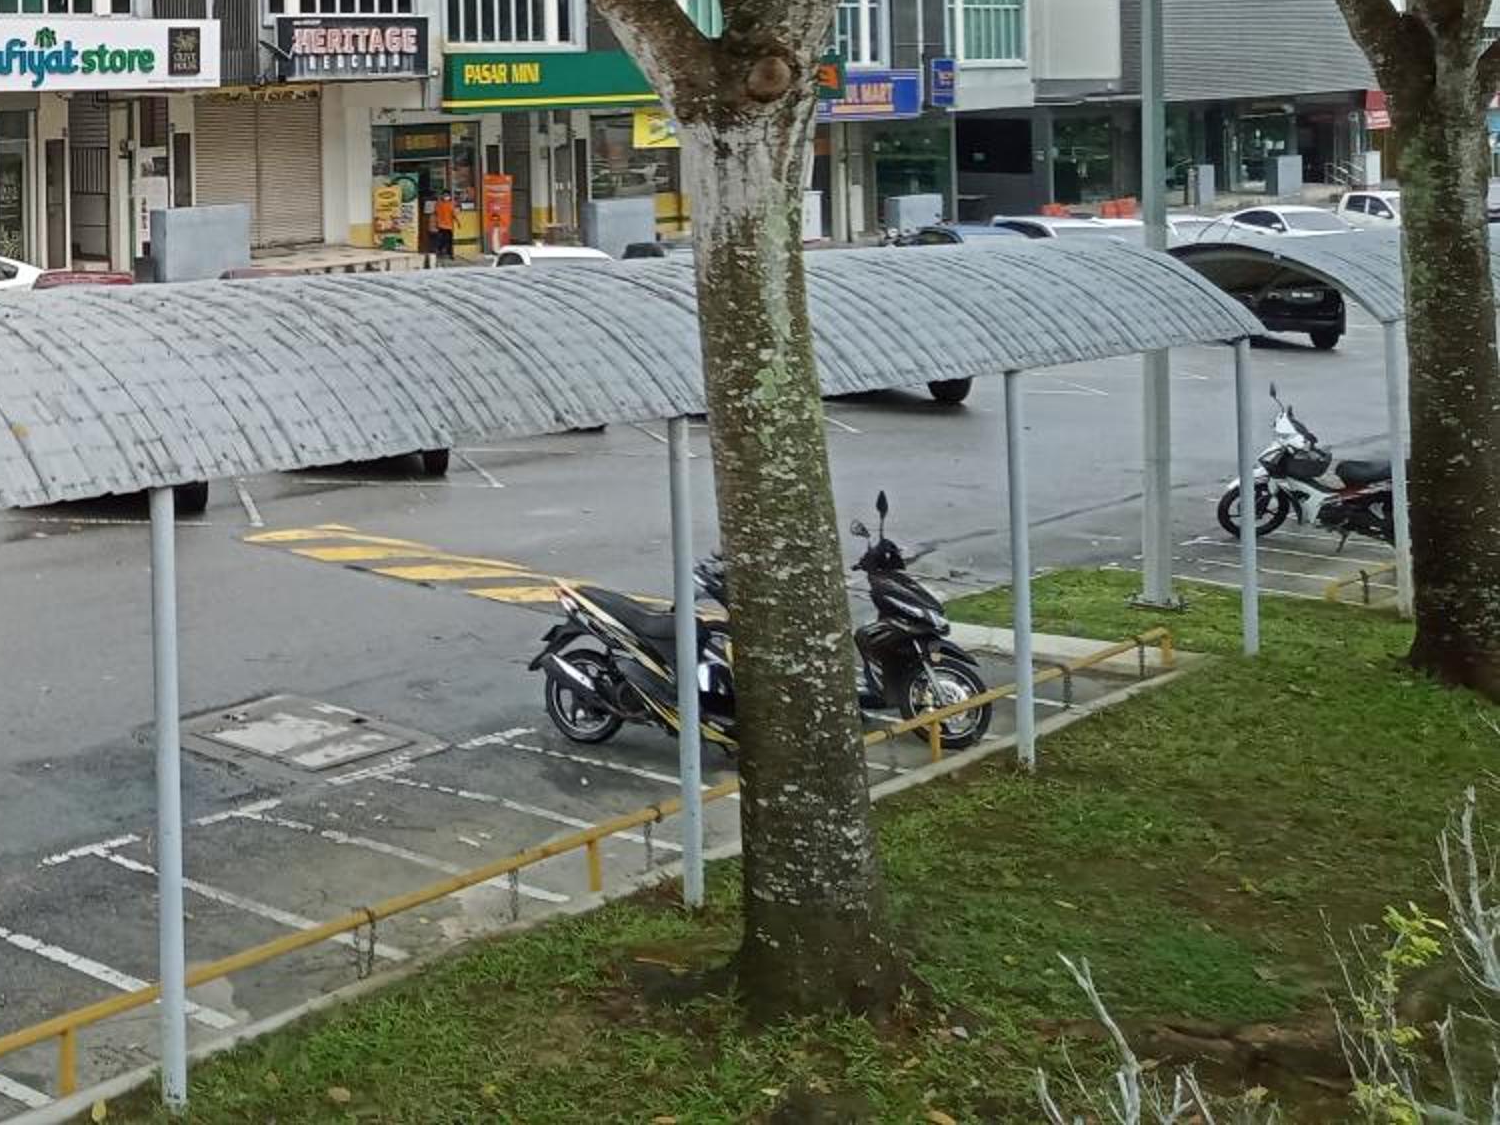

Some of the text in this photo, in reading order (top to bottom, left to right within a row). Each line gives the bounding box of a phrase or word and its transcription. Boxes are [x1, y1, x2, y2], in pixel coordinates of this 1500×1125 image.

[293, 27, 418, 54] HERITAGE
[464, 61, 540, 85] PASAR MINI
